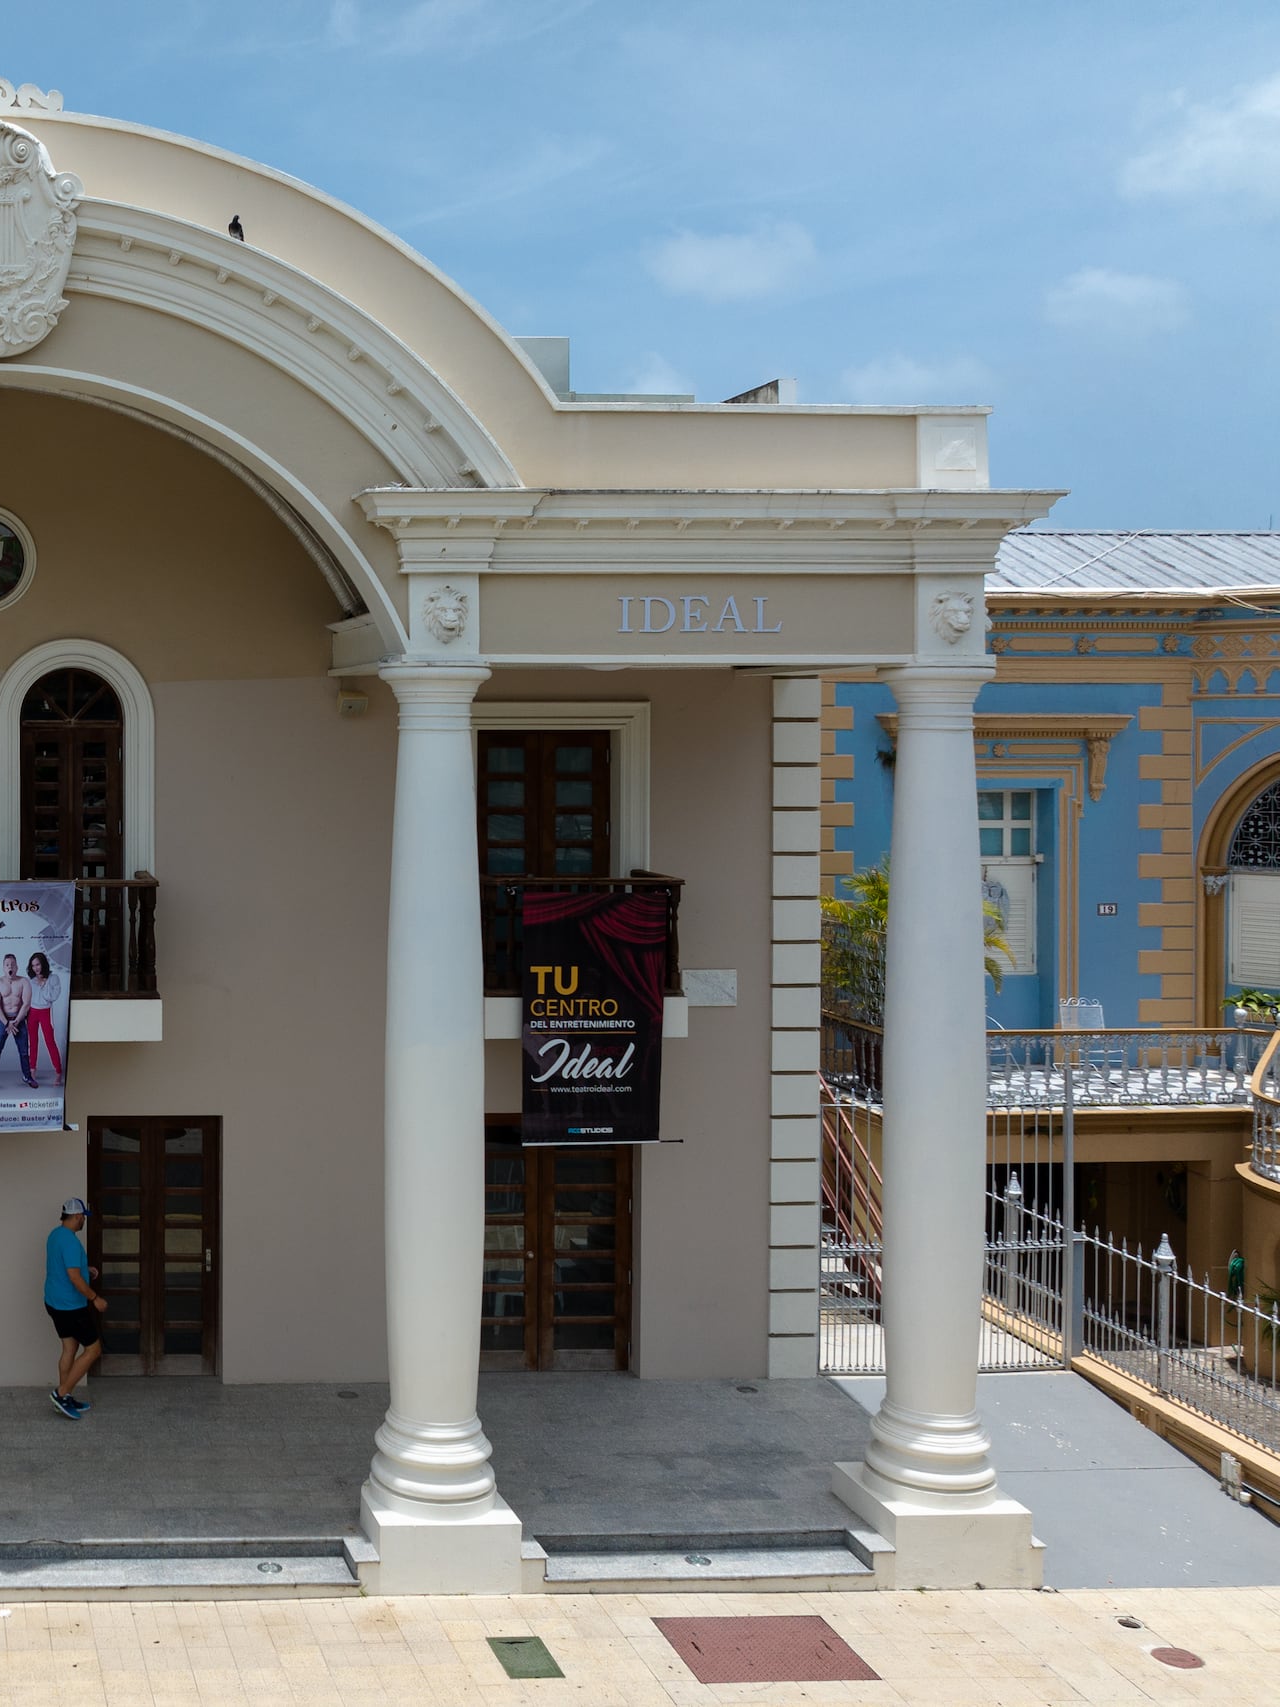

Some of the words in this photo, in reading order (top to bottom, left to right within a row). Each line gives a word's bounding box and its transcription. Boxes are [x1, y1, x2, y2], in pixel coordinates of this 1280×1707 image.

[617, 596, 783, 633] IDEAL
[1103, 905, 1114, 913] 19
[530, 966, 578, 995] TU
[530, 999, 618, 1016] CENTRO
[550, 1020, 635, 1028] ENTRETENIMIENTO
[530, 1038, 635, 1082] Ideal
[550, 1084, 632, 1093] www.teatroideal.com
